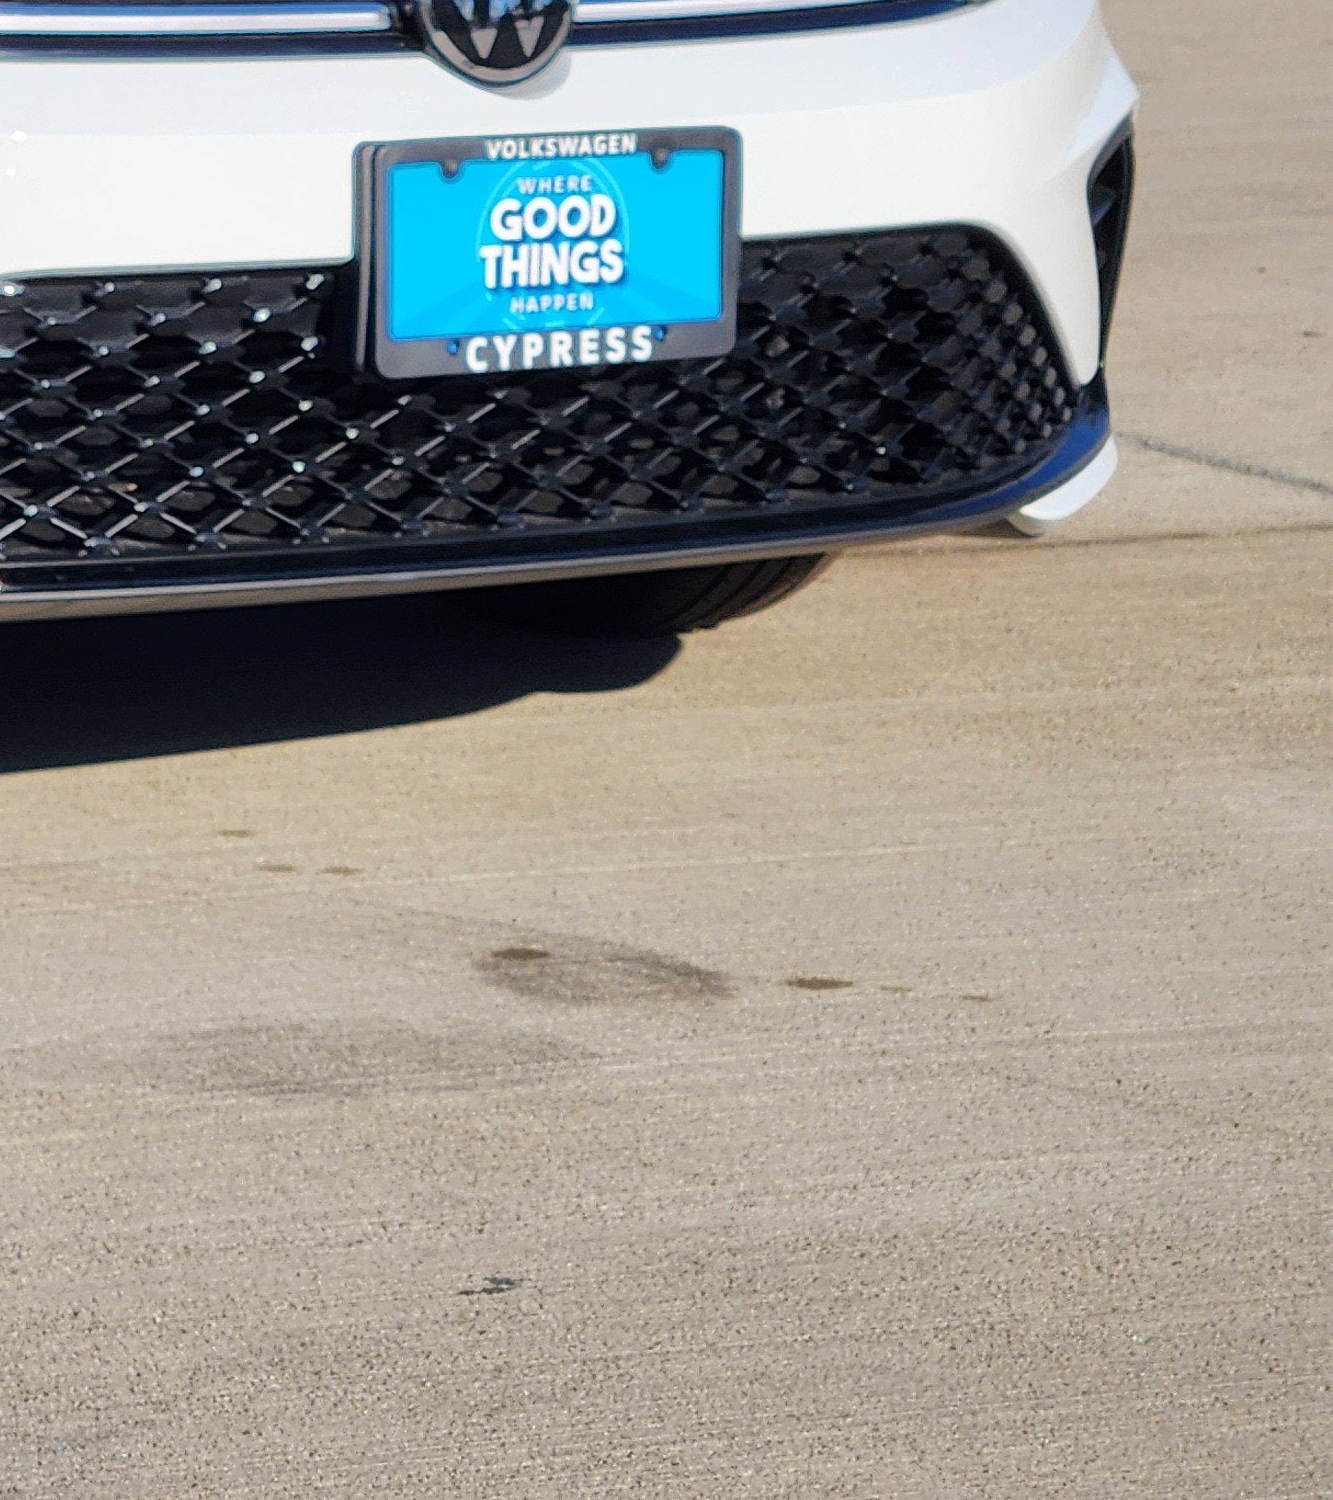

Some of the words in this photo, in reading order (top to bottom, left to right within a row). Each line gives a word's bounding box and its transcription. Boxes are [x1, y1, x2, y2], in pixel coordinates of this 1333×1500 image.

[486, 133, 637, 160] VOLKSWAGEN
[516, 175, 593, 194] WHERE
[490, 194, 616, 241] GOOD
[480, 238, 624, 289] THINGS
[510, 291, 594, 314] HAPPEN
[466, 326, 652, 373] CYPRESS
